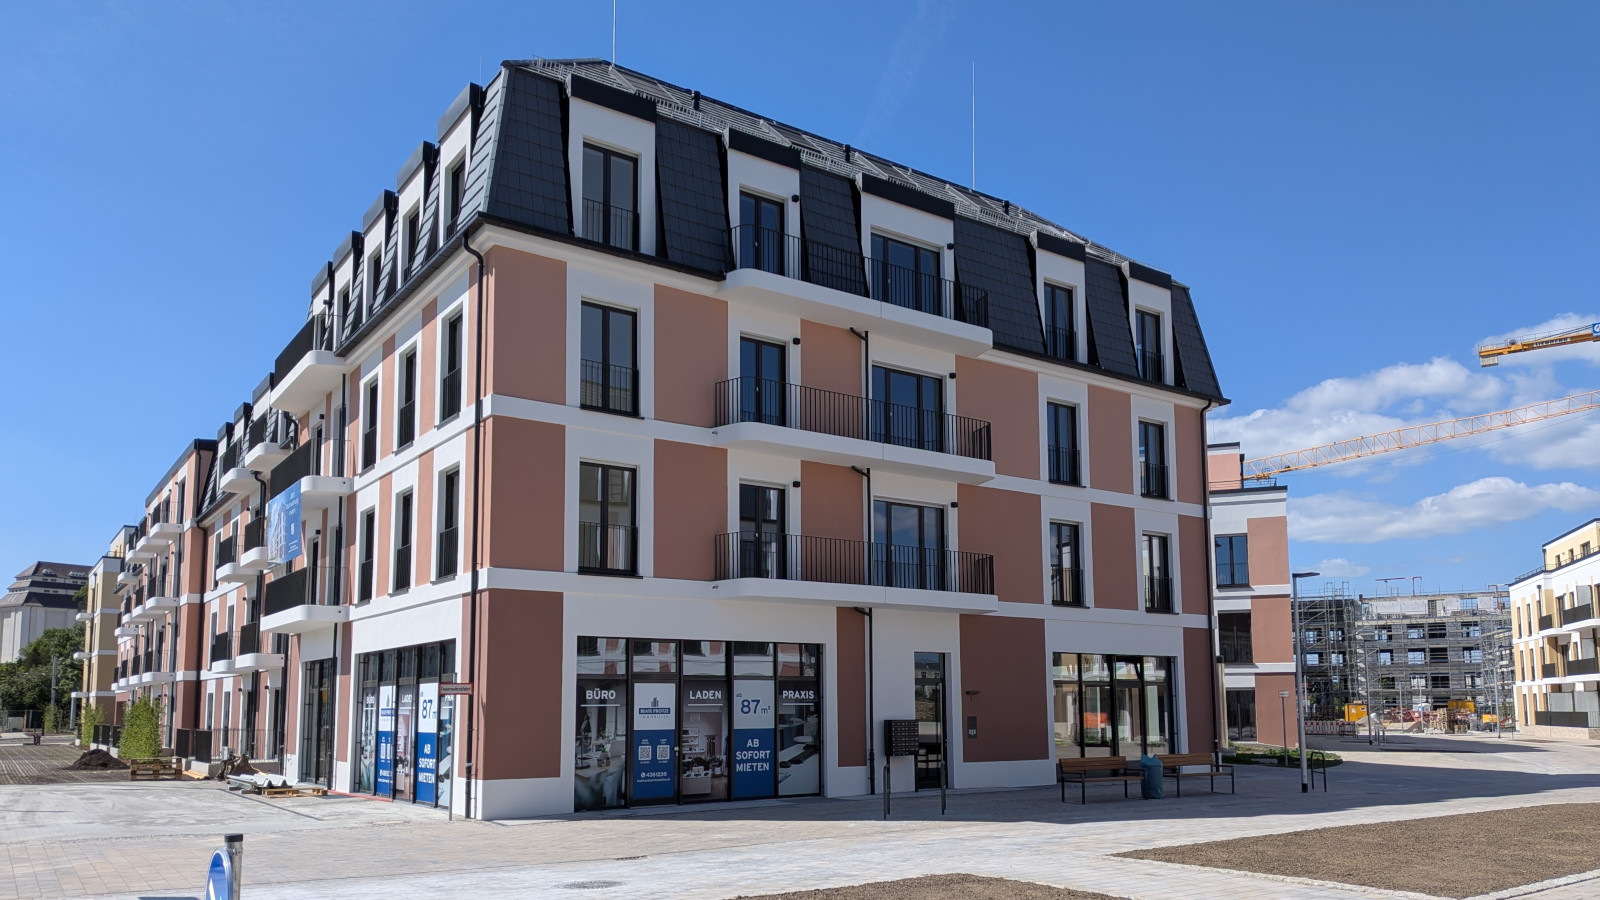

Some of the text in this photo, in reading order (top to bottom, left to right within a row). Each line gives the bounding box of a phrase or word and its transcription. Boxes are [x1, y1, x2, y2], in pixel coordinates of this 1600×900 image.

[586, 688, 616, 700] BÜRO
[689, 690, 722, 700] LADEN
[782, 690, 814, 700] PRAXIS
[422, 699, 433, 720] 87
[740, 699, 760, 714] 87
[746, 739, 760, 748] AB
[424, 744, 430, 754] AB
[736, 750, 770, 760] SOFORT
[418, 758, 436, 769] SOFORT
[736, 762, 770, 772] MIETEN
[418, 772, 434, 784] MIETEN
